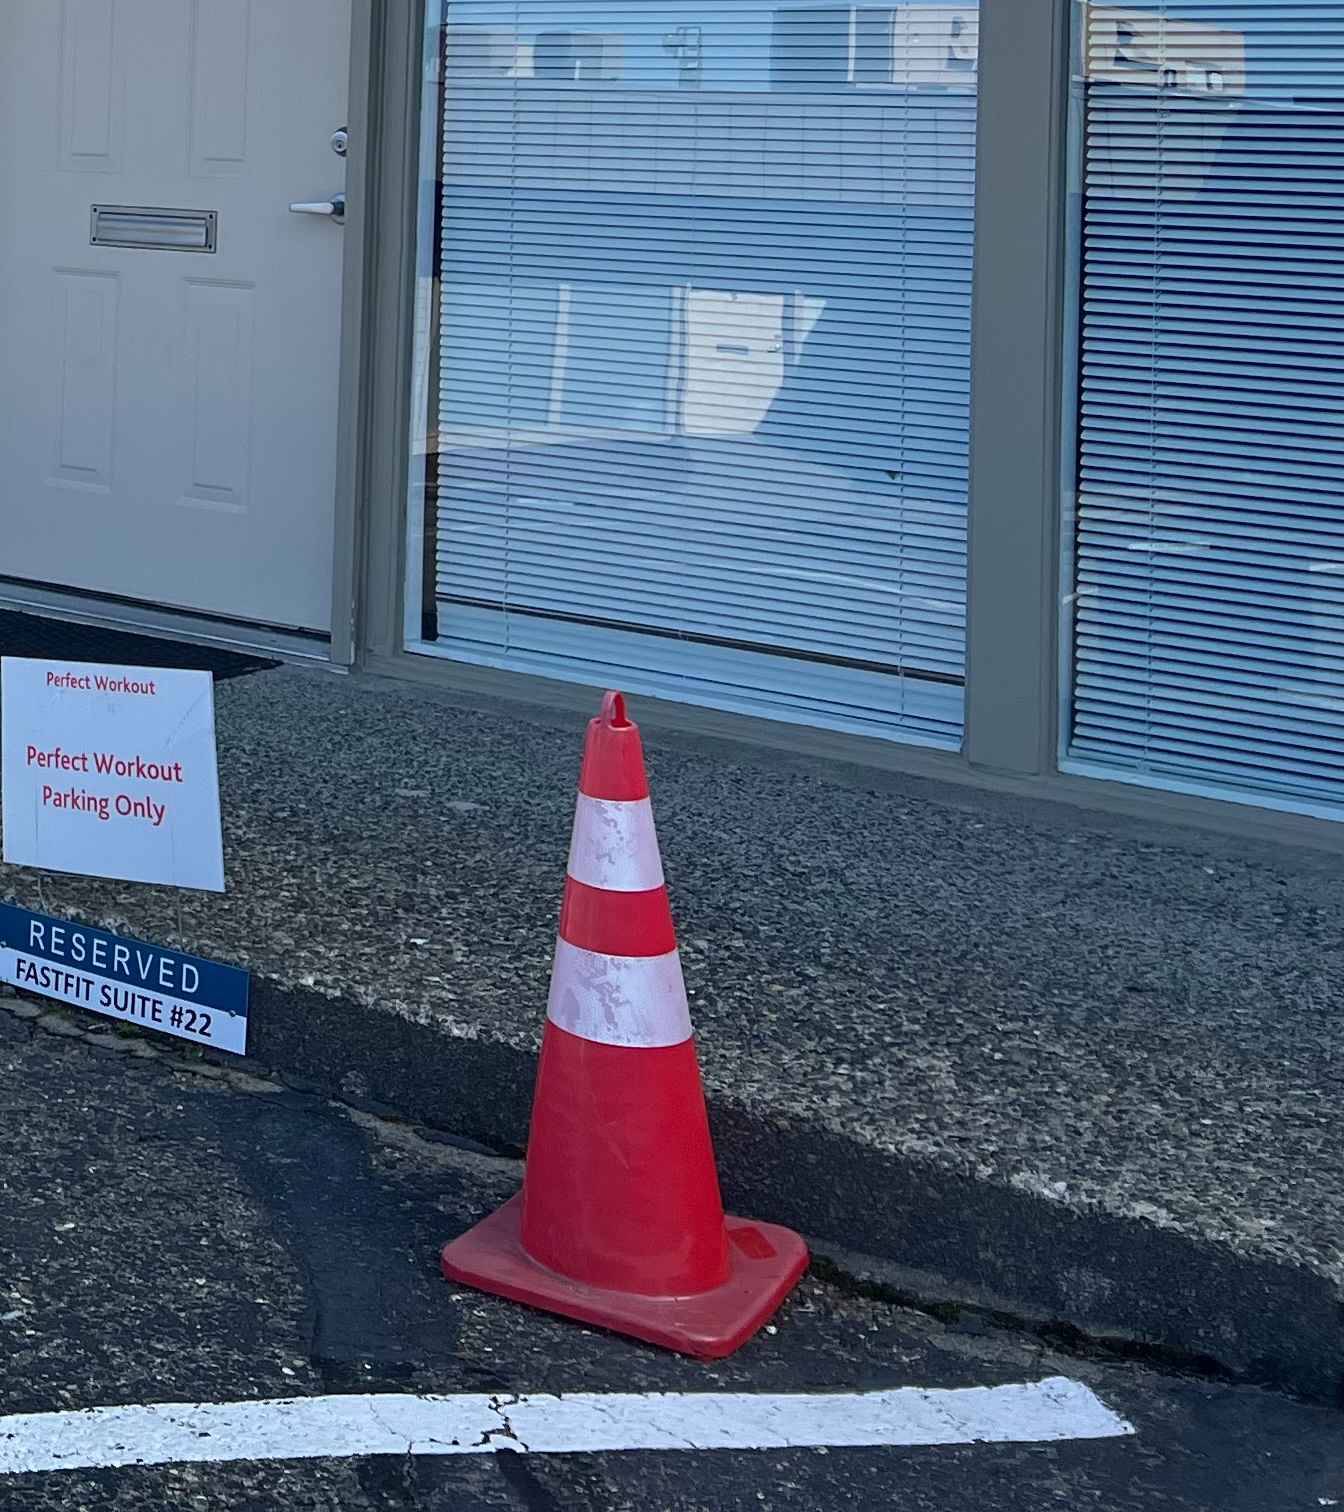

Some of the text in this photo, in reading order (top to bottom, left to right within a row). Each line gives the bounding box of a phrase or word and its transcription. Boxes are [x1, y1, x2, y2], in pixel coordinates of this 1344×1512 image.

[46, 671, 156, 696] Perfect Workout
[26, 745, 184, 783] Perfect Workout
[42, 785, 166, 827] Parking Only
[28, 919, 200, 994] RESERVED
[15, 957, 213, 1038] FASTFIT SUITE #22
